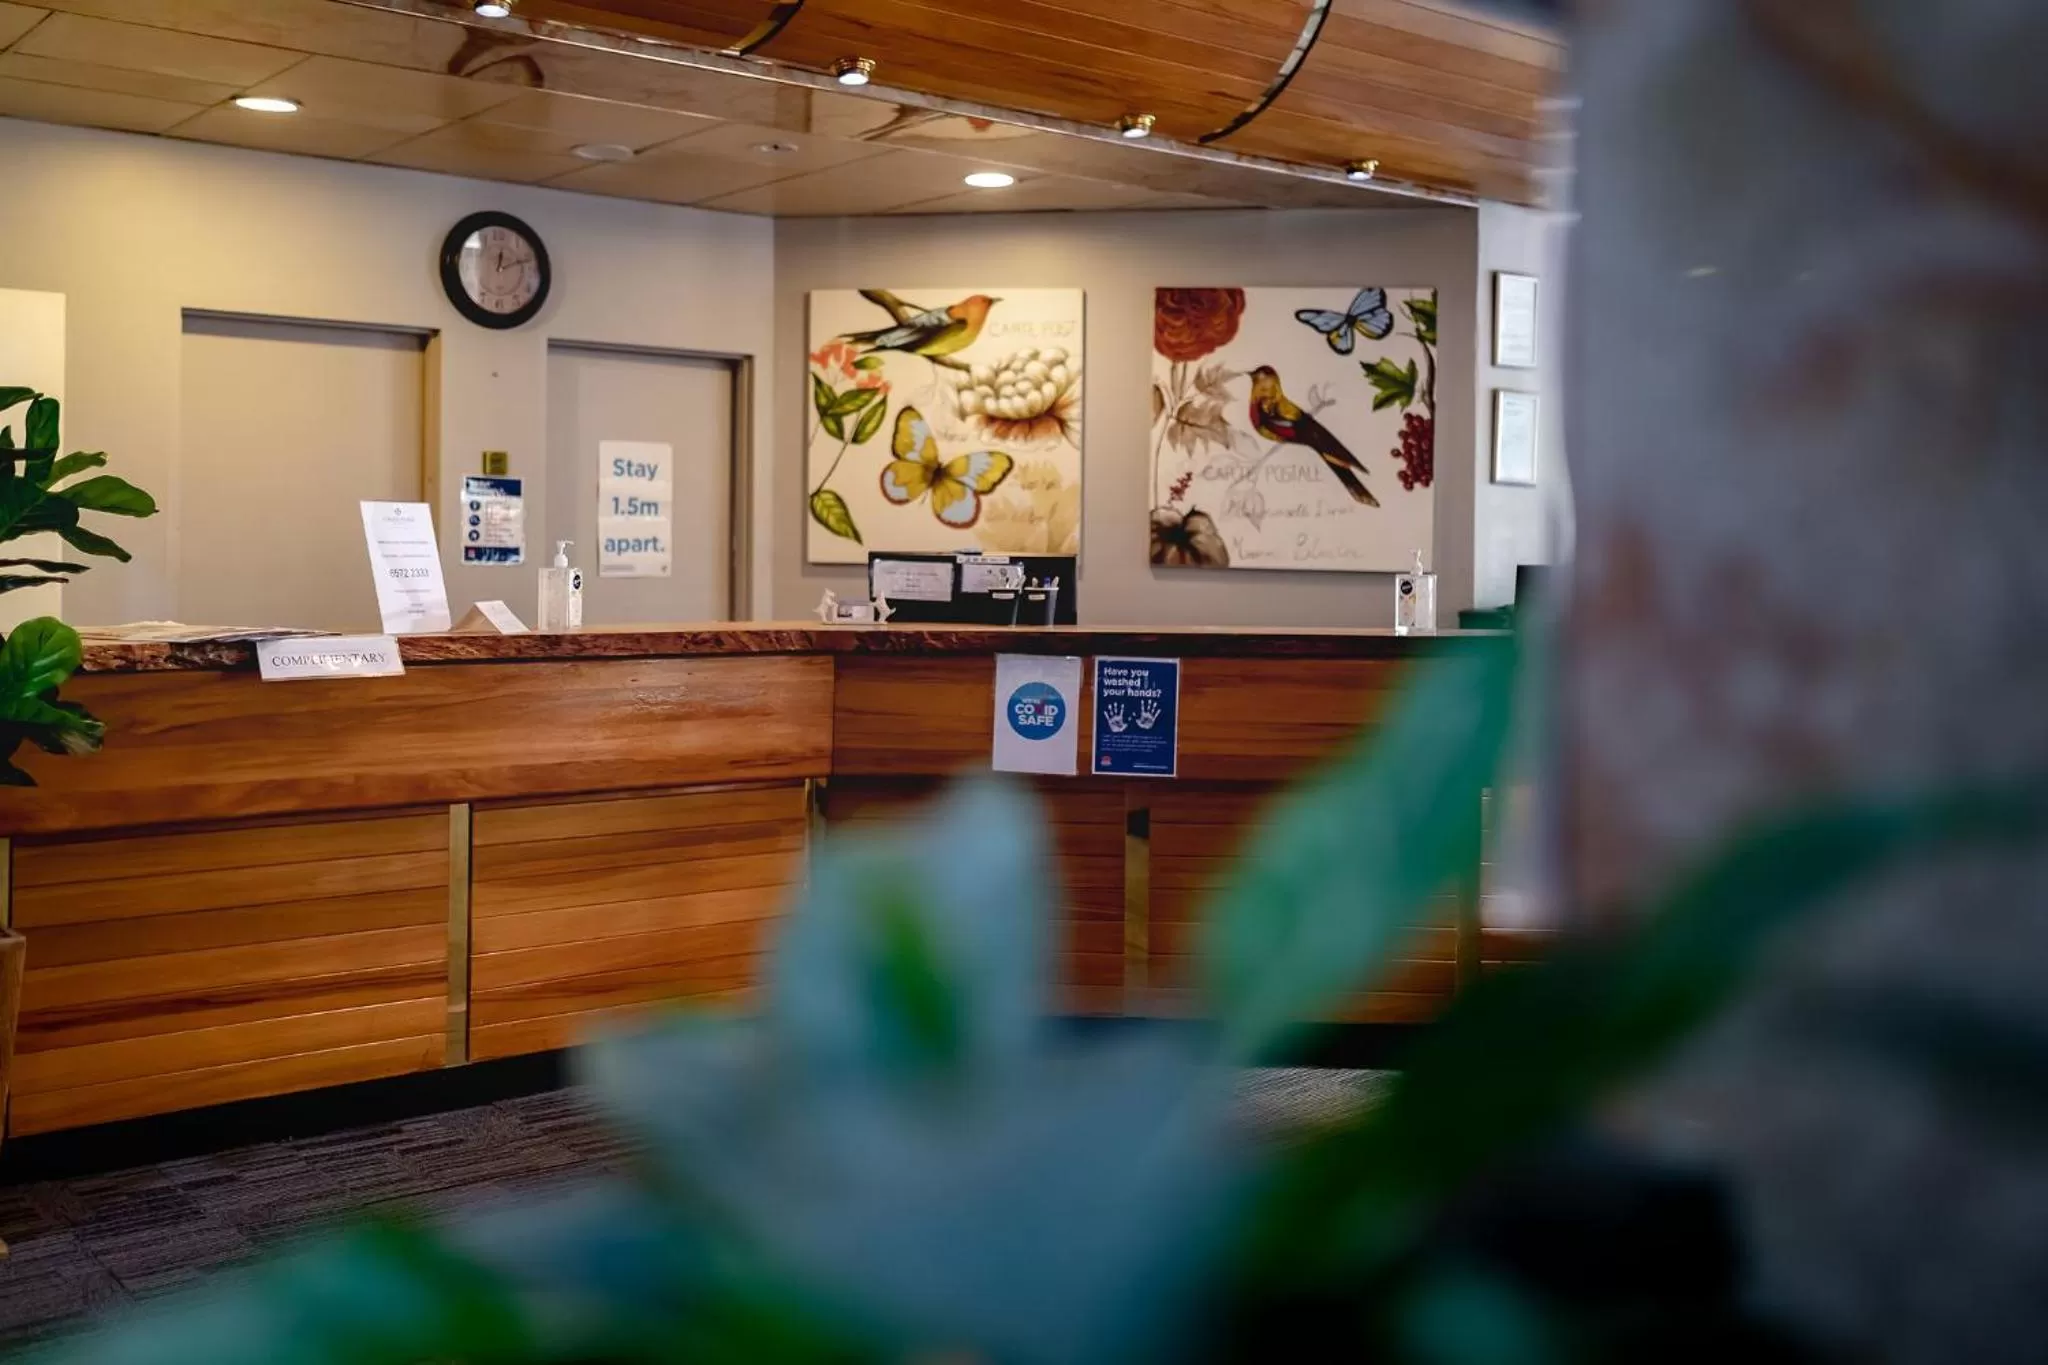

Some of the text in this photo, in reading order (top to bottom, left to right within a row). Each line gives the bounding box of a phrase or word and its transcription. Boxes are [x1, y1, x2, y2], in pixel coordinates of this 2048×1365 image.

[613, 458, 658, 481] Stay
[611, 496, 660, 516] 1.5m
[604, 536, 665, 556] apart.
[1103, 666, 1149, 678] Have you
[1103, 677, 1141, 687] washed
[1103, 687, 1162, 698] your hands?
[1018, 714, 1055, 727] SAFE
